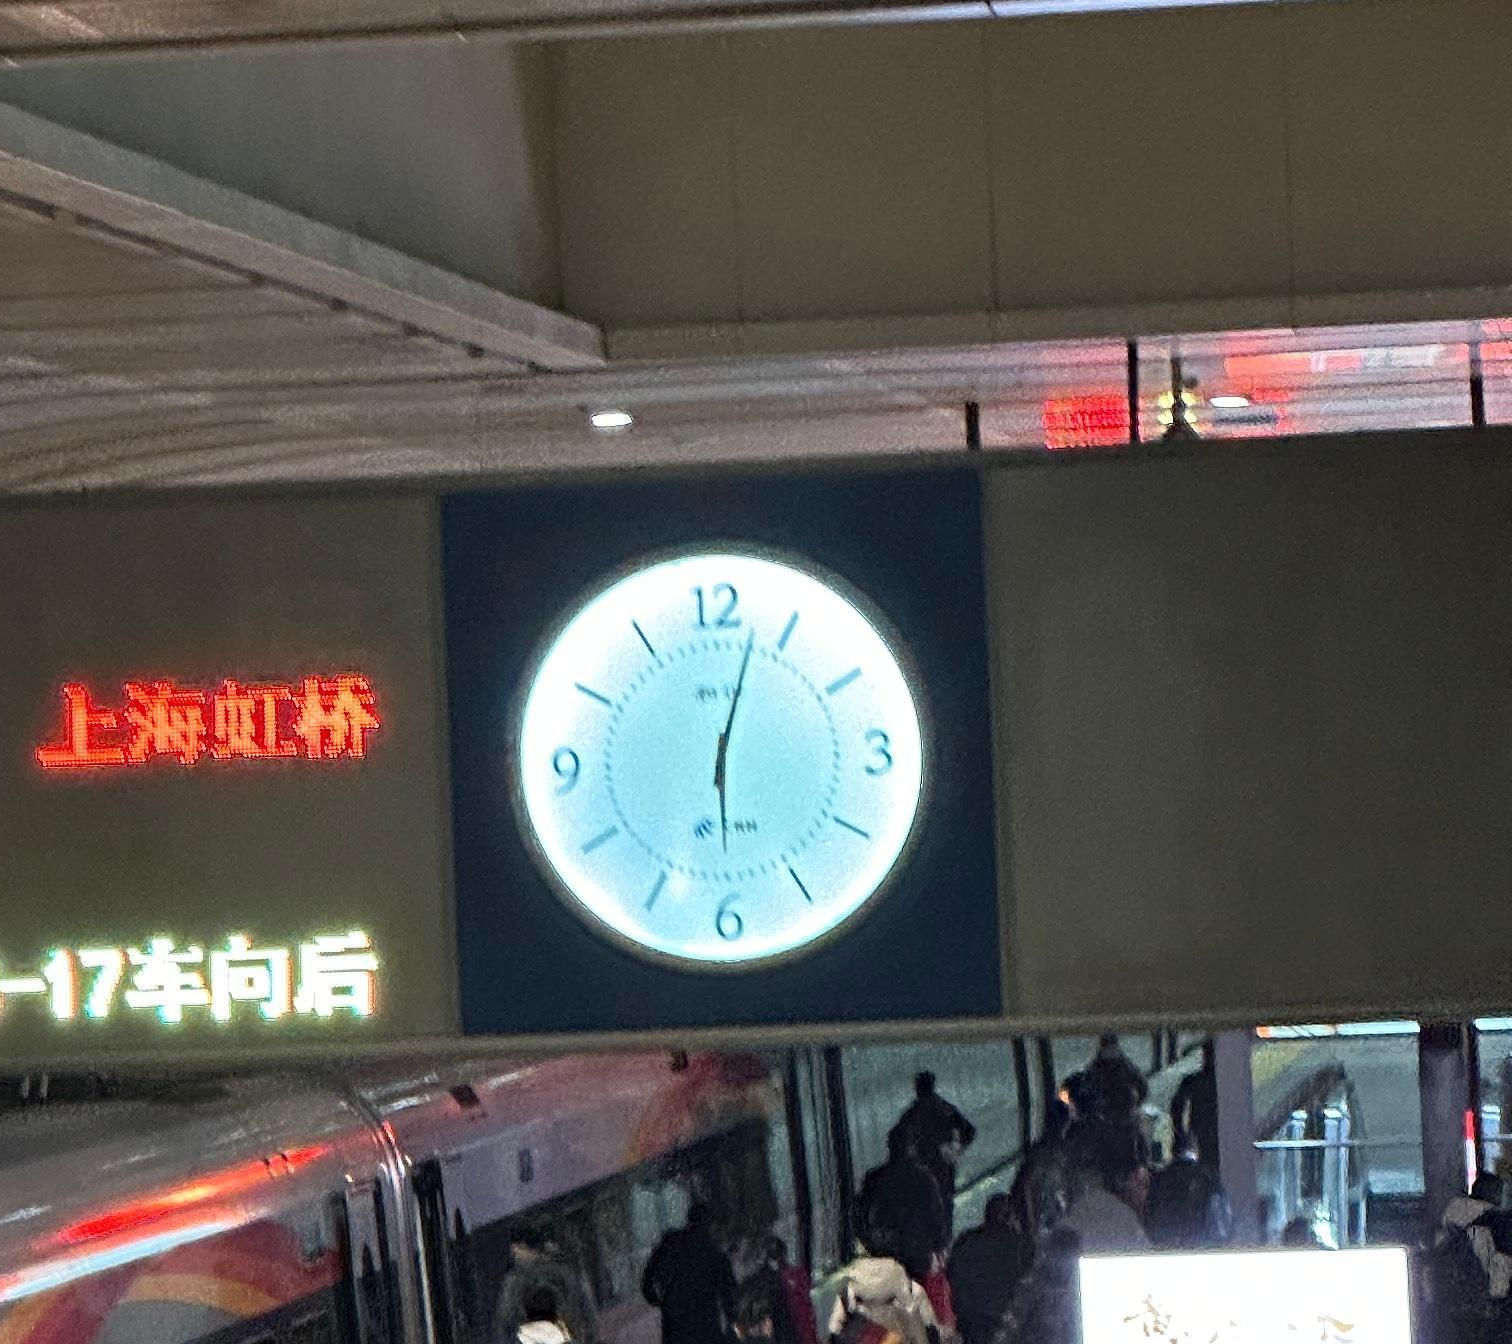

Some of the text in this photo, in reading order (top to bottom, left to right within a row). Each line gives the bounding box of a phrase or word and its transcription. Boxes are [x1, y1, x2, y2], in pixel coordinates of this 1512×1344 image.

[691, 582, 743, 630] 12
[34, 674, 382, 770] 上海虹桥
[552, 745, 582, 796] 9
[863, 729, 893, 777] 3
[715, 894, 744, 941] 6
